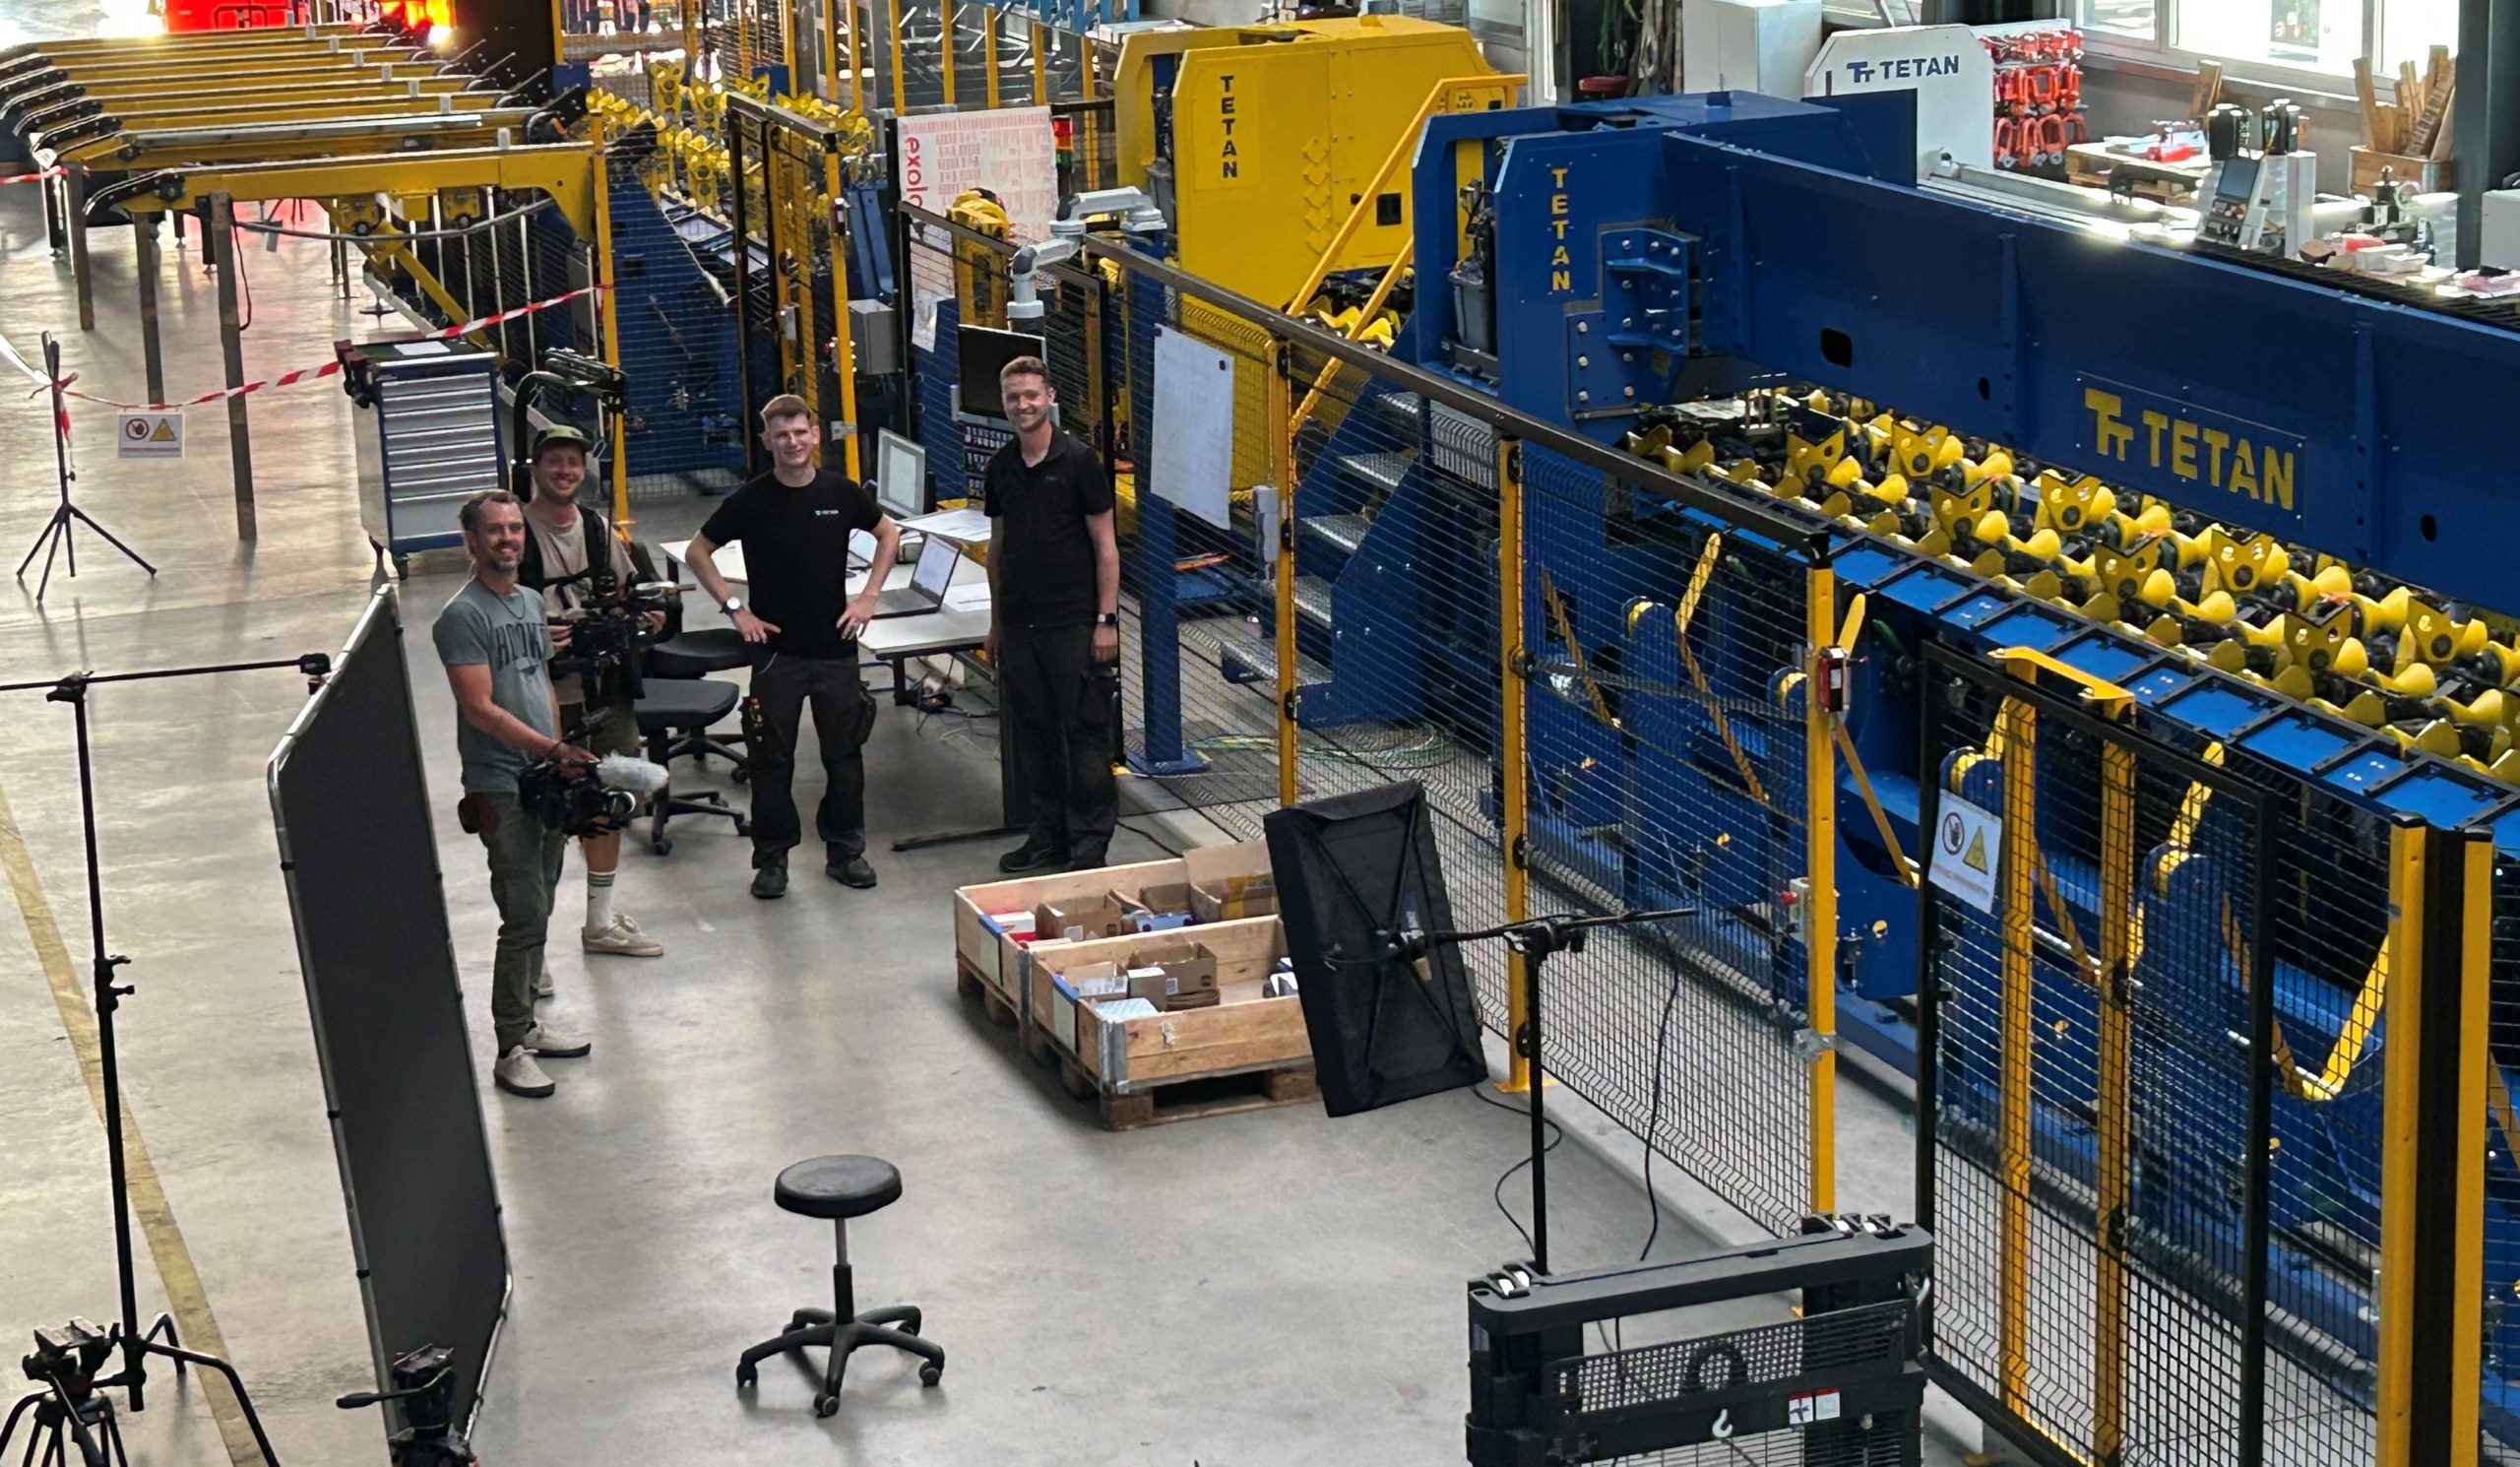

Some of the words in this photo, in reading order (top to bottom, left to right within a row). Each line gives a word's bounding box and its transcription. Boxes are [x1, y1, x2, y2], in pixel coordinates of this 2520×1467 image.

[1879, 55, 1959, 79] TETAN
[1220, 75, 1237, 178] TETAN
[1551, 167, 1570, 290] TETAN
[2142, 410, 2294, 511] TETAN
